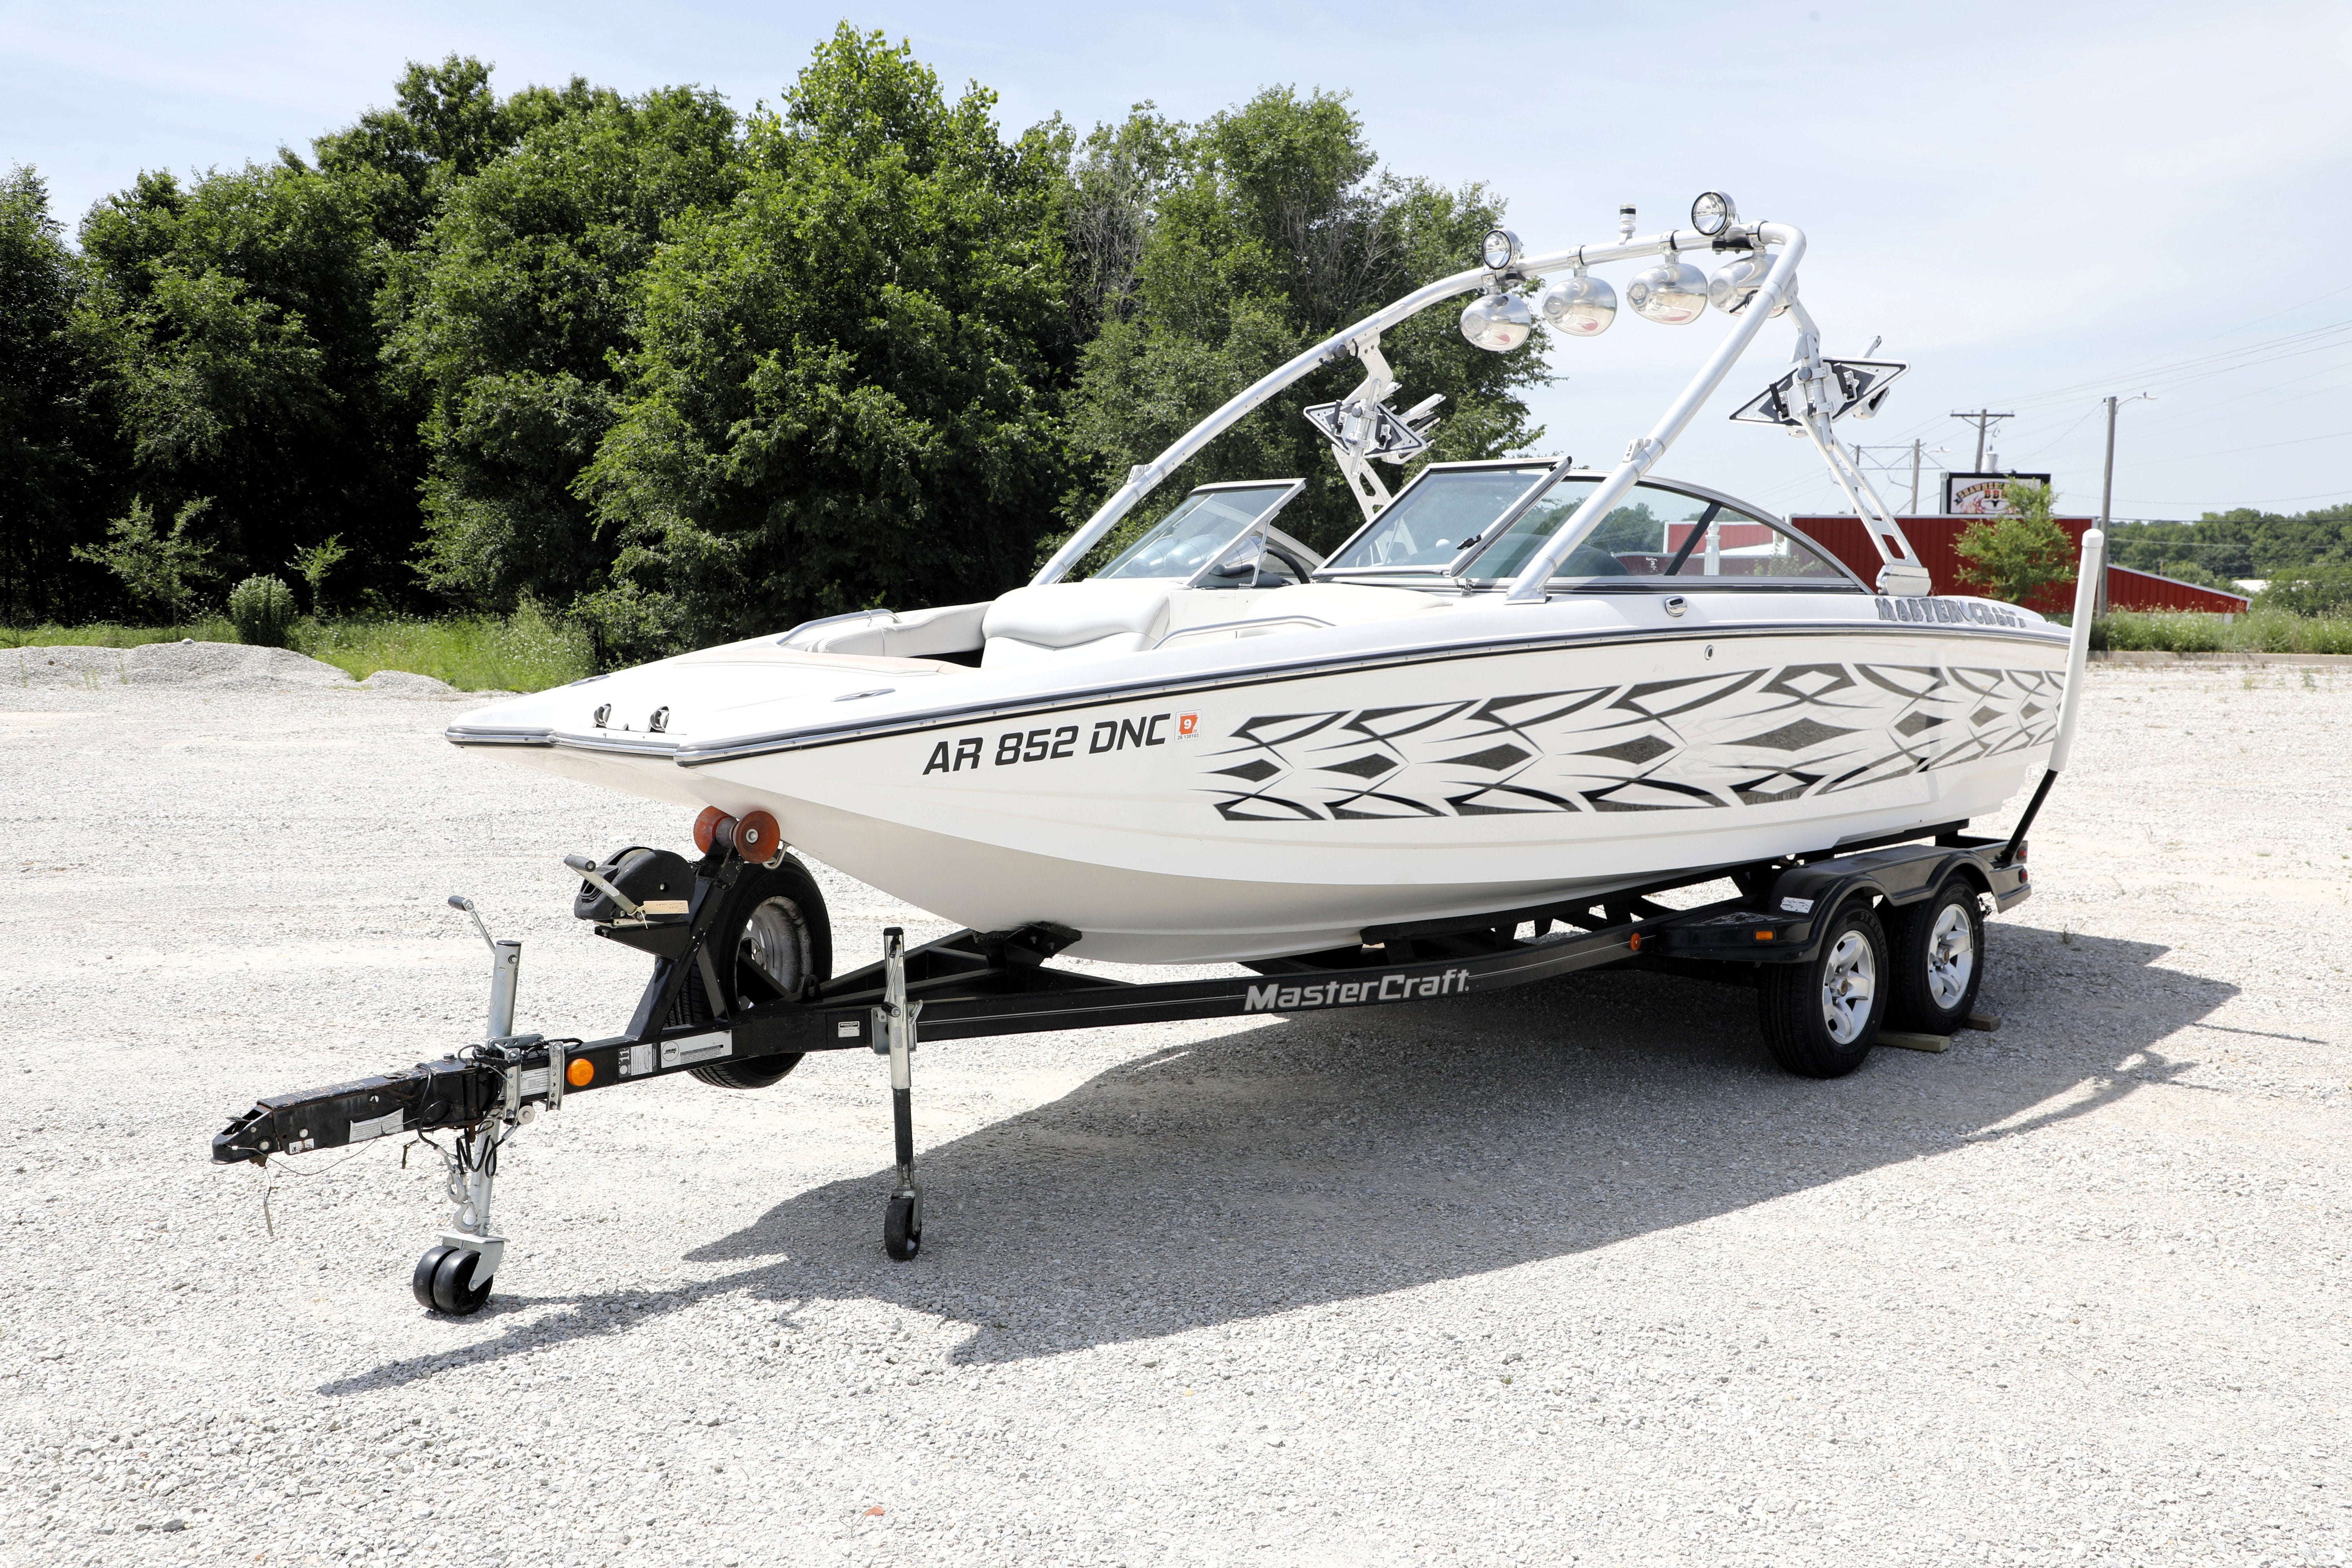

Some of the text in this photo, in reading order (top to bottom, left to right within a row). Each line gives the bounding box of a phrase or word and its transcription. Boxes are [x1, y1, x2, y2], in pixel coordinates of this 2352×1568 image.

[922, 713, 1171, 775] AR 852 DNC
[1184, 719, 1192, 729] 9
[1244, 969, 1470, 1012] MasterCraft
